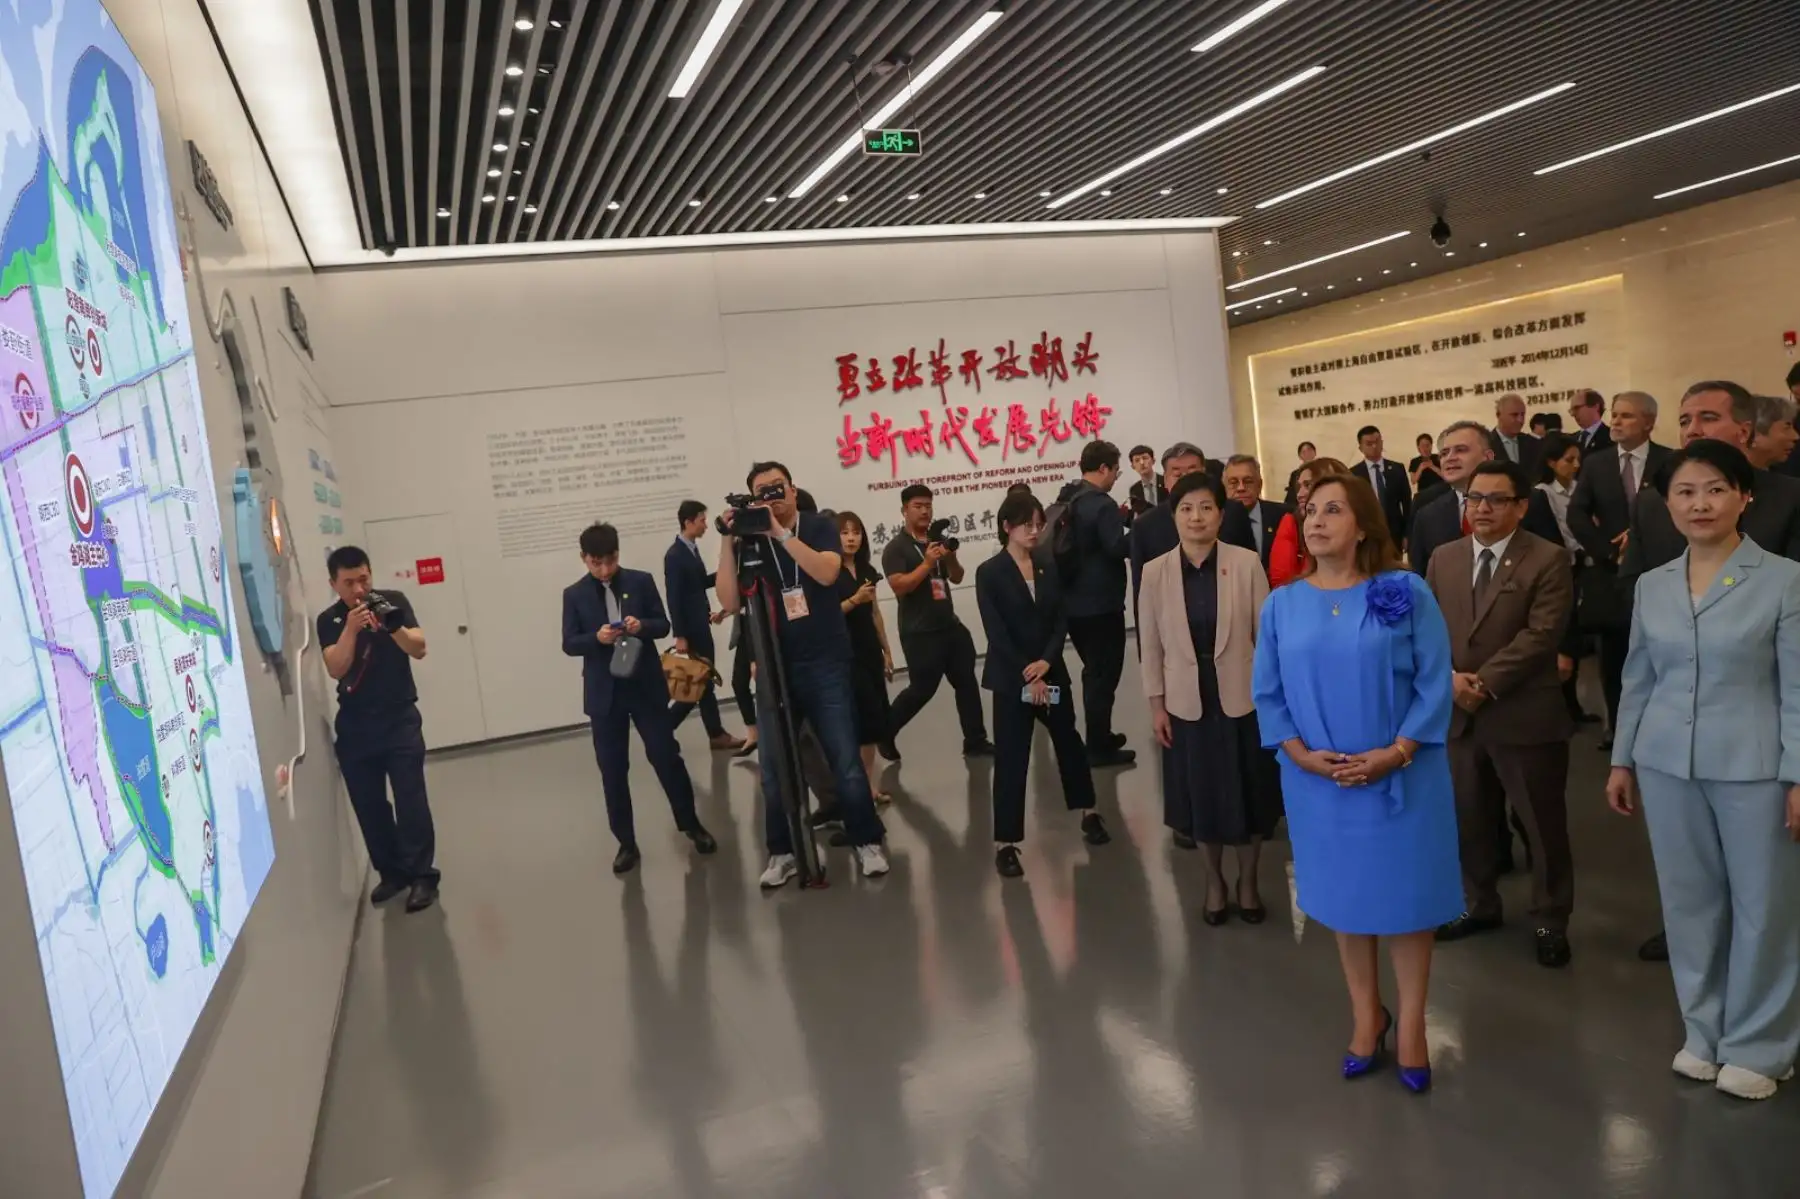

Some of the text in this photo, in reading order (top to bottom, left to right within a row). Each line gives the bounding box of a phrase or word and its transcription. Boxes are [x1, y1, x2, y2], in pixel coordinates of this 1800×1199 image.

[835, 331, 1100, 408] 勇立改革开放潮头
[836, 393, 1113, 478] 当新时代发展先锋
[868, 480, 908, 491] PURSUING
[910, 478, 925, 487] THE
[926, 472, 972, 485] FOREFRONT
[973, 471, 983, 480] OF
[985, 467, 1016, 478] REFORM
[1017, 465, 1032, 474] AND
[1033, 460, 1077, 472] OPENING-UP
[942, 487, 951, 496] TO
[954, 485, 964, 495] BE
[965, 483, 980, 493] THE
[982, 479, 1013, 490] PIONEER
[1026, 477, 1031, 485] A
[1032, 475, 1048, 485] NEW
[1049, 473, 1065, 482] ERA
[69, 542, 109, 567] 金鸡湖主中心
